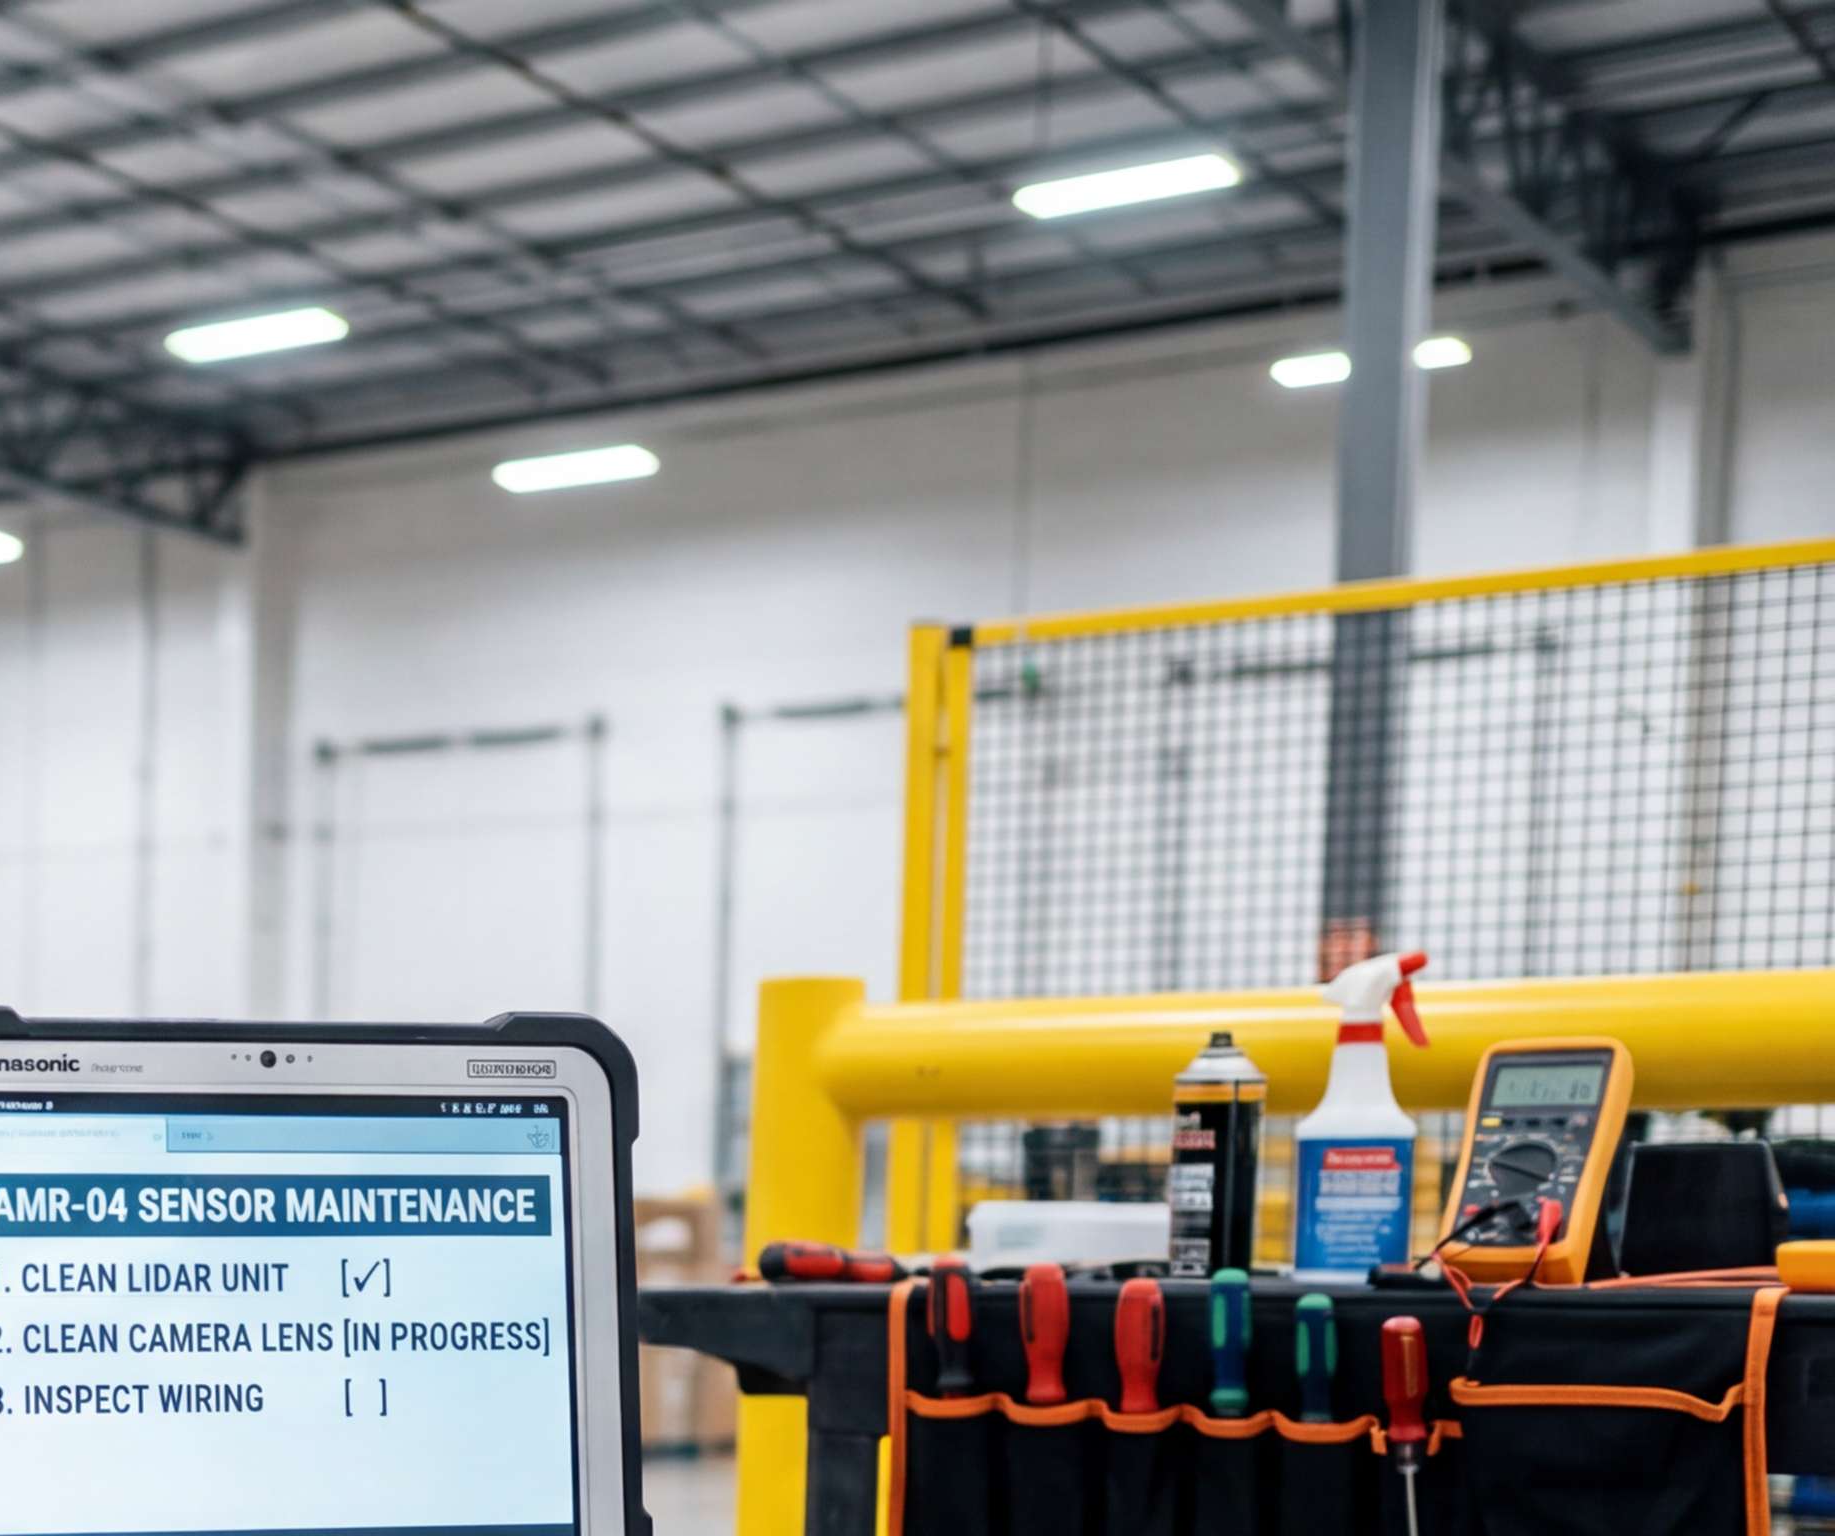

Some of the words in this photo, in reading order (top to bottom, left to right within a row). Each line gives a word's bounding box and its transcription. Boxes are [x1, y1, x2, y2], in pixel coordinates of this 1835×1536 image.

[138, 1186, 276, 1224] SENSOR
[285, 1186, 536, 1224] MAINTENANCE
[22, 1263, 117, 1293] CLEAN
[128, 1263, 212, 1293] LIDAR
[222, 1262, 289, 1292] UNIT
[23, 1323, 118, 1354] CLEAN
[129, 1323, 252, 1353] CAMERA
[262, 1322, 333, 1352] LENS
[25, 1384, 150, 1414] INSPECT
[158, 1383, 264, 1413] WIRING
